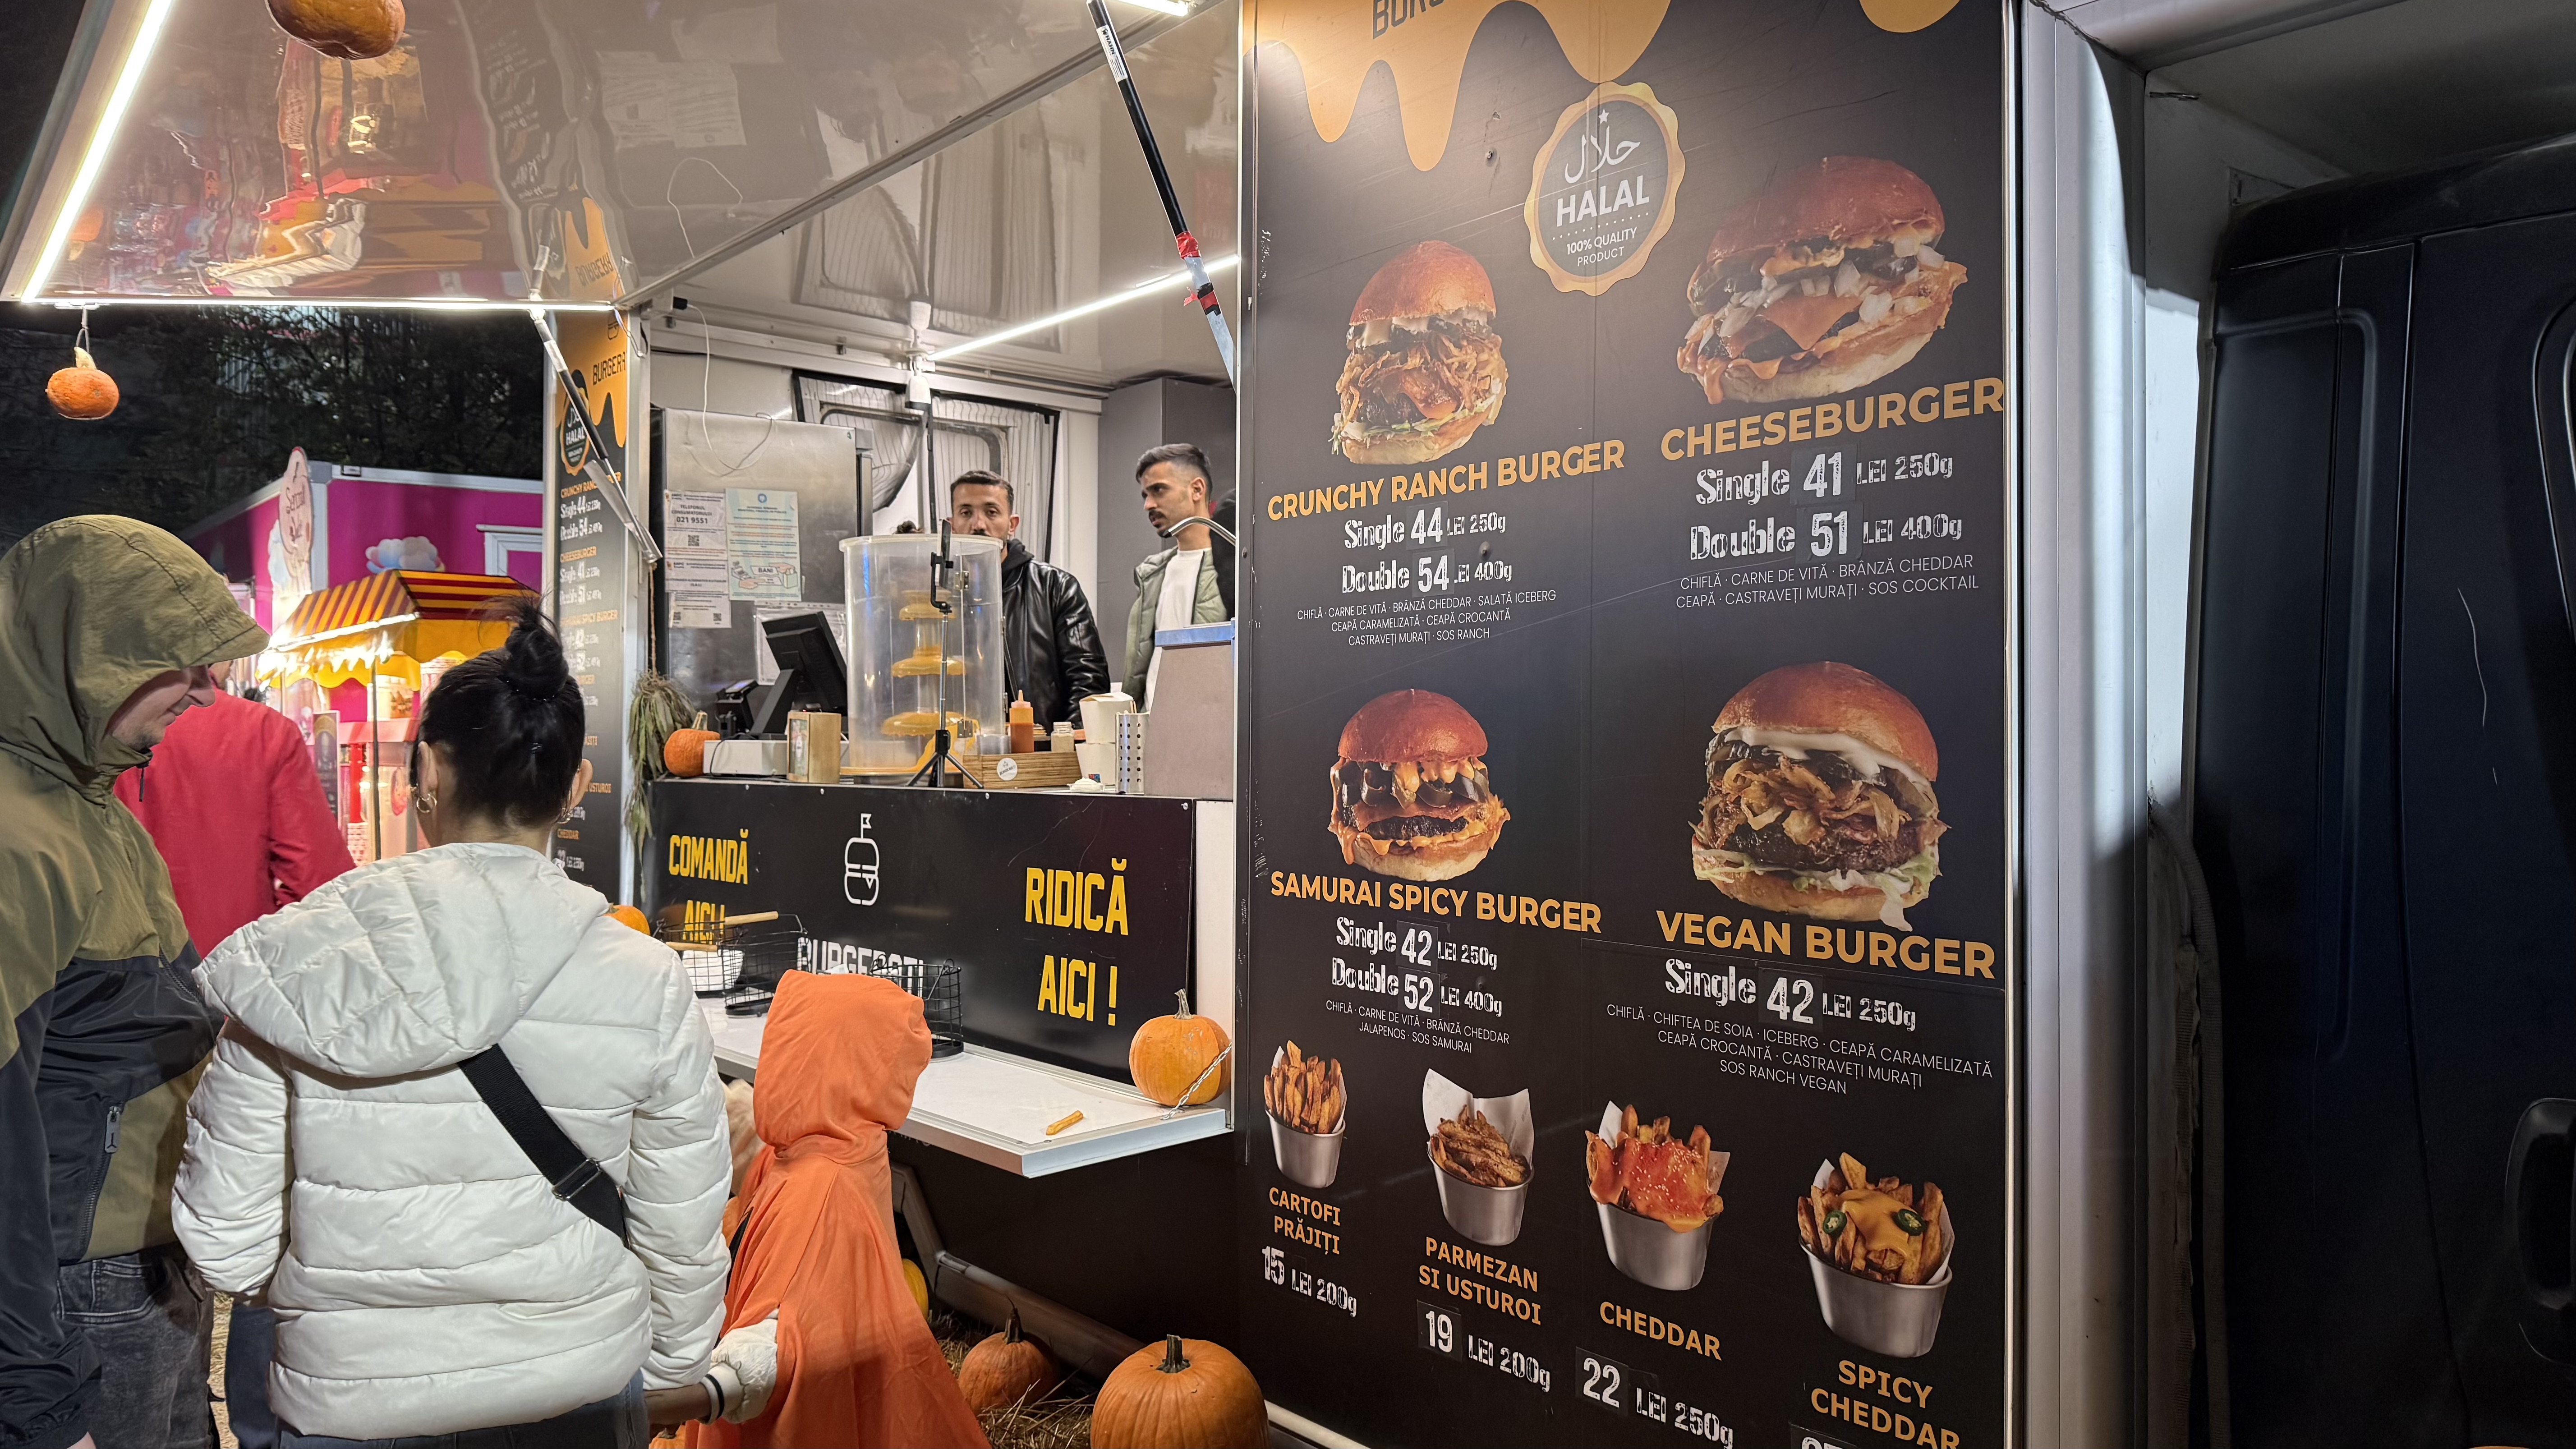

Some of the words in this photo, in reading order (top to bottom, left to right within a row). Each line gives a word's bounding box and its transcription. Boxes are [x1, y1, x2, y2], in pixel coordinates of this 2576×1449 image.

[1565, 126, 1640, 183] حلال
[1557, 175, 1649, 227] HALAL
[1567, 239, 1592, 254] 100%
[1594, 227, 1637, 248] QUALITY
[1578, 246, 1624, 267] PRODUCT
[566, 427, 585, 446] HALAL
[1661, 377, 2003, 460] CHEESEBURGER
[1268, 478, 1384, 520] CRUNCHY
[1392, 462, 1487, 502] RANCH
[1498, 440, 1624, 486] BURGER
[1696, 460, 1789, 504] Single
[1803, 452, 1841, 497] 41
[1857, 460, 1886, 484] LEI
[1895, 453, 1952, 479] 250g
[1345, 515, 1404, 550] Single
[1411, 507, 1443, 544] 44
[1447, 517, 1465, 535] LEI
[1470, 512, 1505, 533] 250g
[1691, 517, 1794, 560] Double
[1811, 511, 1847, 556] 51
[1863, 520, 1892, 543] LEI
[1901, 514, 1961, 540] 400g
[1343, 560, 1409, 593] Double
[1418, 556, 1449, 592] 54
[1475, 561, 1512, 581] 400g
[1677, 592, 1715, 607] CEAPĂ
[1726, 588, 1801, 604] CASTRAVEȚI
[1807, 584, 1856, 599] MURAȚI
[1869, 581, 1897, 594] SOS
[1903, 575, 1978, 592] COCKTAIL
[1681, 573, 1721, 589] CHIFLĂ
[1732, 571, 1773, 585] CARNE
[1779, 569, 1794, 581] DE
[1799, 563, 1827, 580] VITĂ
[1840, 558, 1894, 577] BRÂNZĂ
[1900, 555, 1973, 572] CHEDDAR
[1297, 607, 1322, 619] CHIFLĂ
[1329, 606, 1354, 617] CARNE
[1357, 605, 1366, 615] DE
[1370, 602, 1386, 614] VITĂ
[1394, 598, 1425, 612] BRÂNZĂ
[1429, 597, 1471, 609] CHEDDAR
[1479, 591, 1512, 606] SALATĂ
[1516, 590, 1556, 603] ICEBERG
[1332, 619, 1357, 631] CEAPĂ
[1360, 614, 1420, 630] CARAMELIZATĂ
[1427, 612, 1455, 625] CEAPĂ
[1458, 607, 1510, 623] CROCANTĂ
[1349, 634, 1396, 646] CASTRAVEȚI
[1399, 631, 1430, 644] MURAȚI
[1437, 630, 1454, 640] SOS
[1458, 628, 1489, 639] RANCH
[669, 829, 748, 884] COMANDĂ
[1026, 858, 1128, 935] RIDICĂ
[1271, 871, 1380, 907] SAMURAI
[1389, 883, 1468, 916] SPICY
[1477, 892, 1601, 933] BURGER
[1337, 917, 1396, 955] Single
[1401, 929, 1432, 966] 42
[1438, 942, 1456, 961] LEI
[1461, 945, 1497, 970] 250g
[1656, 911, 1790, 955] VEGAN
[1806, 925, 1995, 979] BURGER
[1038, 955, 1095, 1021] AICI
[1332, 957, 1398, 995] Double
[1404, 975, 1433, 1012] 52
[1441, 986, 1459, 1006] LEI
[1464, 991, 1501, 1017] 400g
[1665, 959, 1756, 1006] Single
[1767, 977, 1813, 1024] 42
[1823, 993, 1851, 1018] LEI
[1859, 998, 1915, 1031] 250g
[1326, 1000, 1352, 1014] CHIFLĂ
[1359, 1006, 1385, 1020] CARNE
[1389, 1012, 1398, 1023] DE
[1402, 1014, 1420, 1027] VITĂ
[1427, 1019, 1461, 1035] BRÂNZĂ
[1464, 1026, 1509, 1044] CHEDDAR
[1359, 1022, 1405, 1040] JALAPENOS
[1412, 1032, 1429, 1044] SOS
[1432, 1036, 1471, 1053] SAMURAI
[1607, 1004, 1644, 1021] CHIFLĂ
[1654, 1012, 1701, 1030] CHIFTEA
[1706, 1020, 1720, 1033] DE
[1725, 1023, 1753, 1038] SOIA
[1764, 1029, 1818, 1049] ICEBERG
[1830, 1040, 1876, 1058] CEAPĂ
[1881, 1048, 1992, 1079] CARAMELIZATĂ
[1659, 1031, 1696, 1048] CEAPĂ
[1701, 1038, 1771, 1061] CROCANTĂ
[1783, 1052, 1863, 1081] CASTRAVEȚI
[1869, 1066, 1921, 1089] MURAȚI
[1720, 1060, 1745, 1075] SOS
[1750, 1065, 1794, 1084] RANCH
[1800, 1074, 1846, 1094] VEGAN
[1270, 1187, 1340, 1226] CARTOFI
[1275, 1216, 1339, 1254] PRĂJIȚI
[1262, 1246, 1284, 1284] 15
[1292, 1269, 1311, 1296] LEI
[1317, 1279, 1356, 1317] 200g
[1426, 1237, 1537, 1293] PARMEZAN
[1419, 1265, 1439, 1289] SI
[1447, 1272, 1541, 1325] USTUROI
[1426, 1311, 1452, 1352] 19
[1469, 1335, 1493, 1366] LEI
[1500, 1348, 1550, 1392] 200g
[1601, 1302, 1721, 1361] CHEDDAR
[1583, 1358, 1620, 1408] 22
[1637, 1388, 1666, 1422] LEI
[1675, 1403, 1733, 1449] 250g
[1839, 1360, 1932, 1408] SPICY
[1812, 1386, 1959, 1449] CHEDDAR
